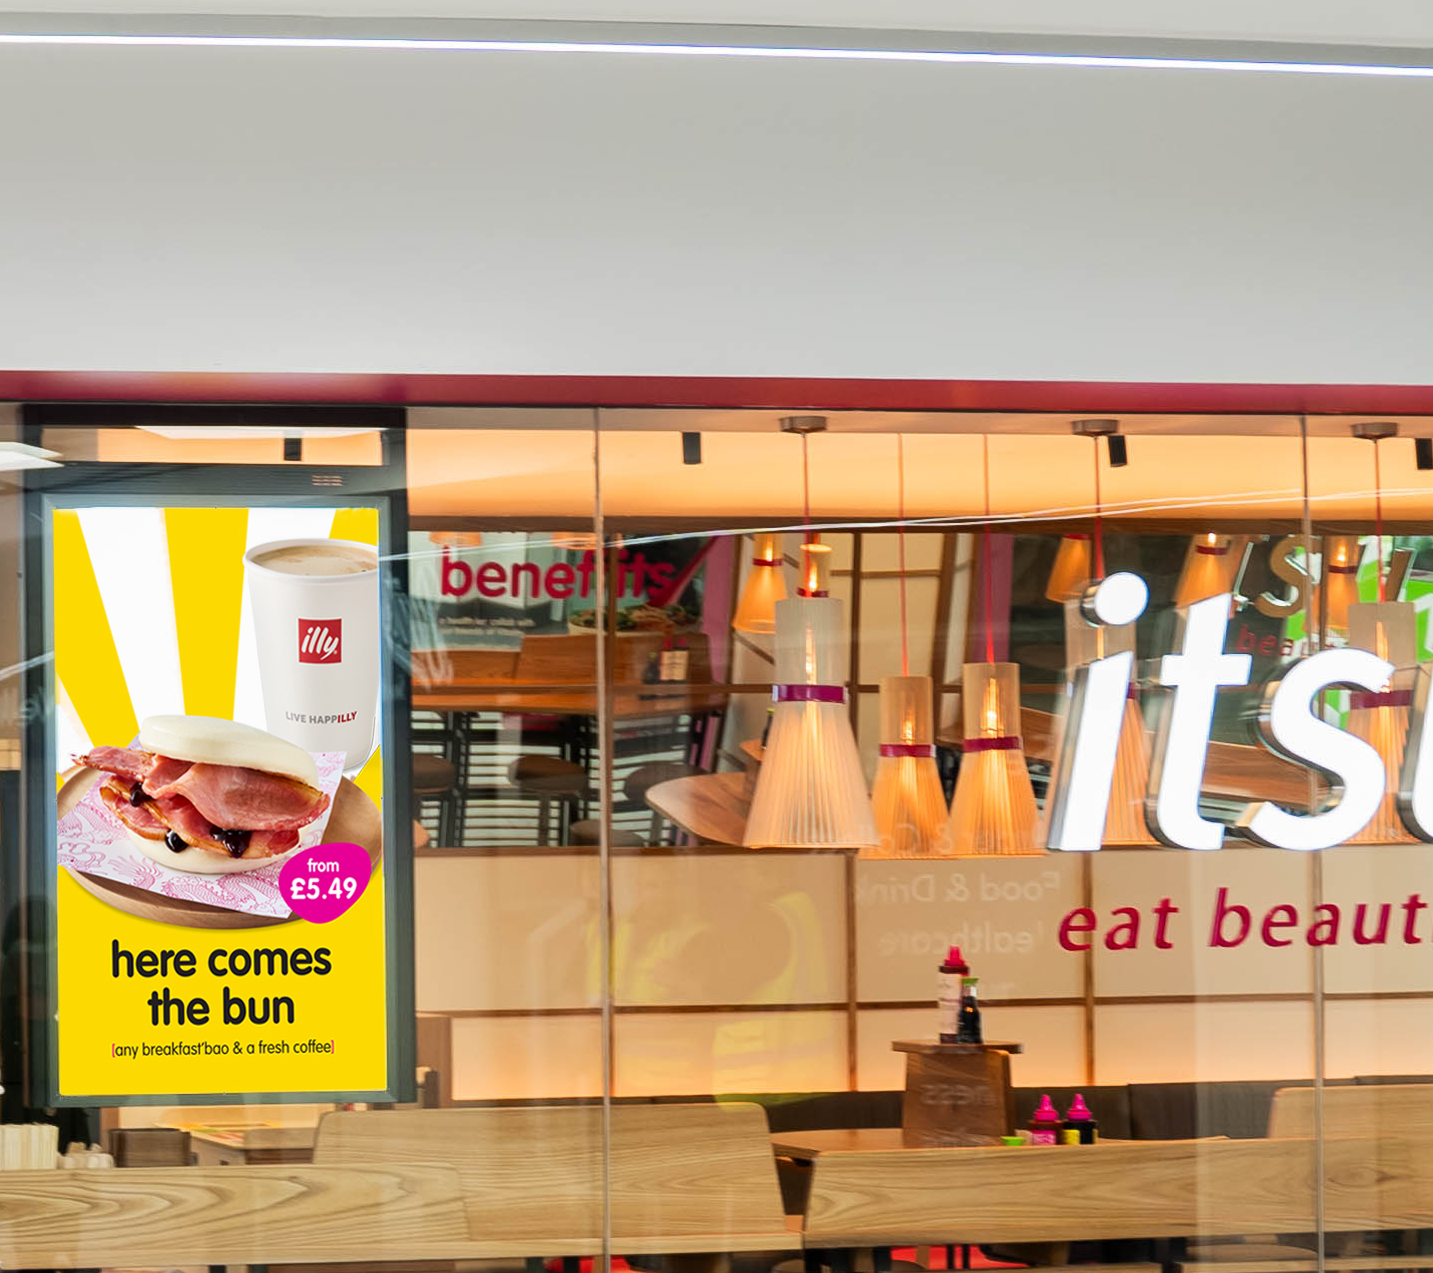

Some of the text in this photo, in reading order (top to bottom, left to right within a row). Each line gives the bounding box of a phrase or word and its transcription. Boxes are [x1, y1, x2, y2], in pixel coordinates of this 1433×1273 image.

[301, 626, 339, 660] illy
[285, 711, 358, 724] LIVE HAPPILLY
[307, 858, 340, 873] from
[290, 877, 357, 900] £5.49
[1058, 897, 1180, 952] eat
[112, 939, 332, 978] here comes
[147, 986, 295, 1026] the bun
[232, 1041, 243, 1055] &
[246, 1043, 255, 1054] a
[259, 1040, 290, 1054] fresh
